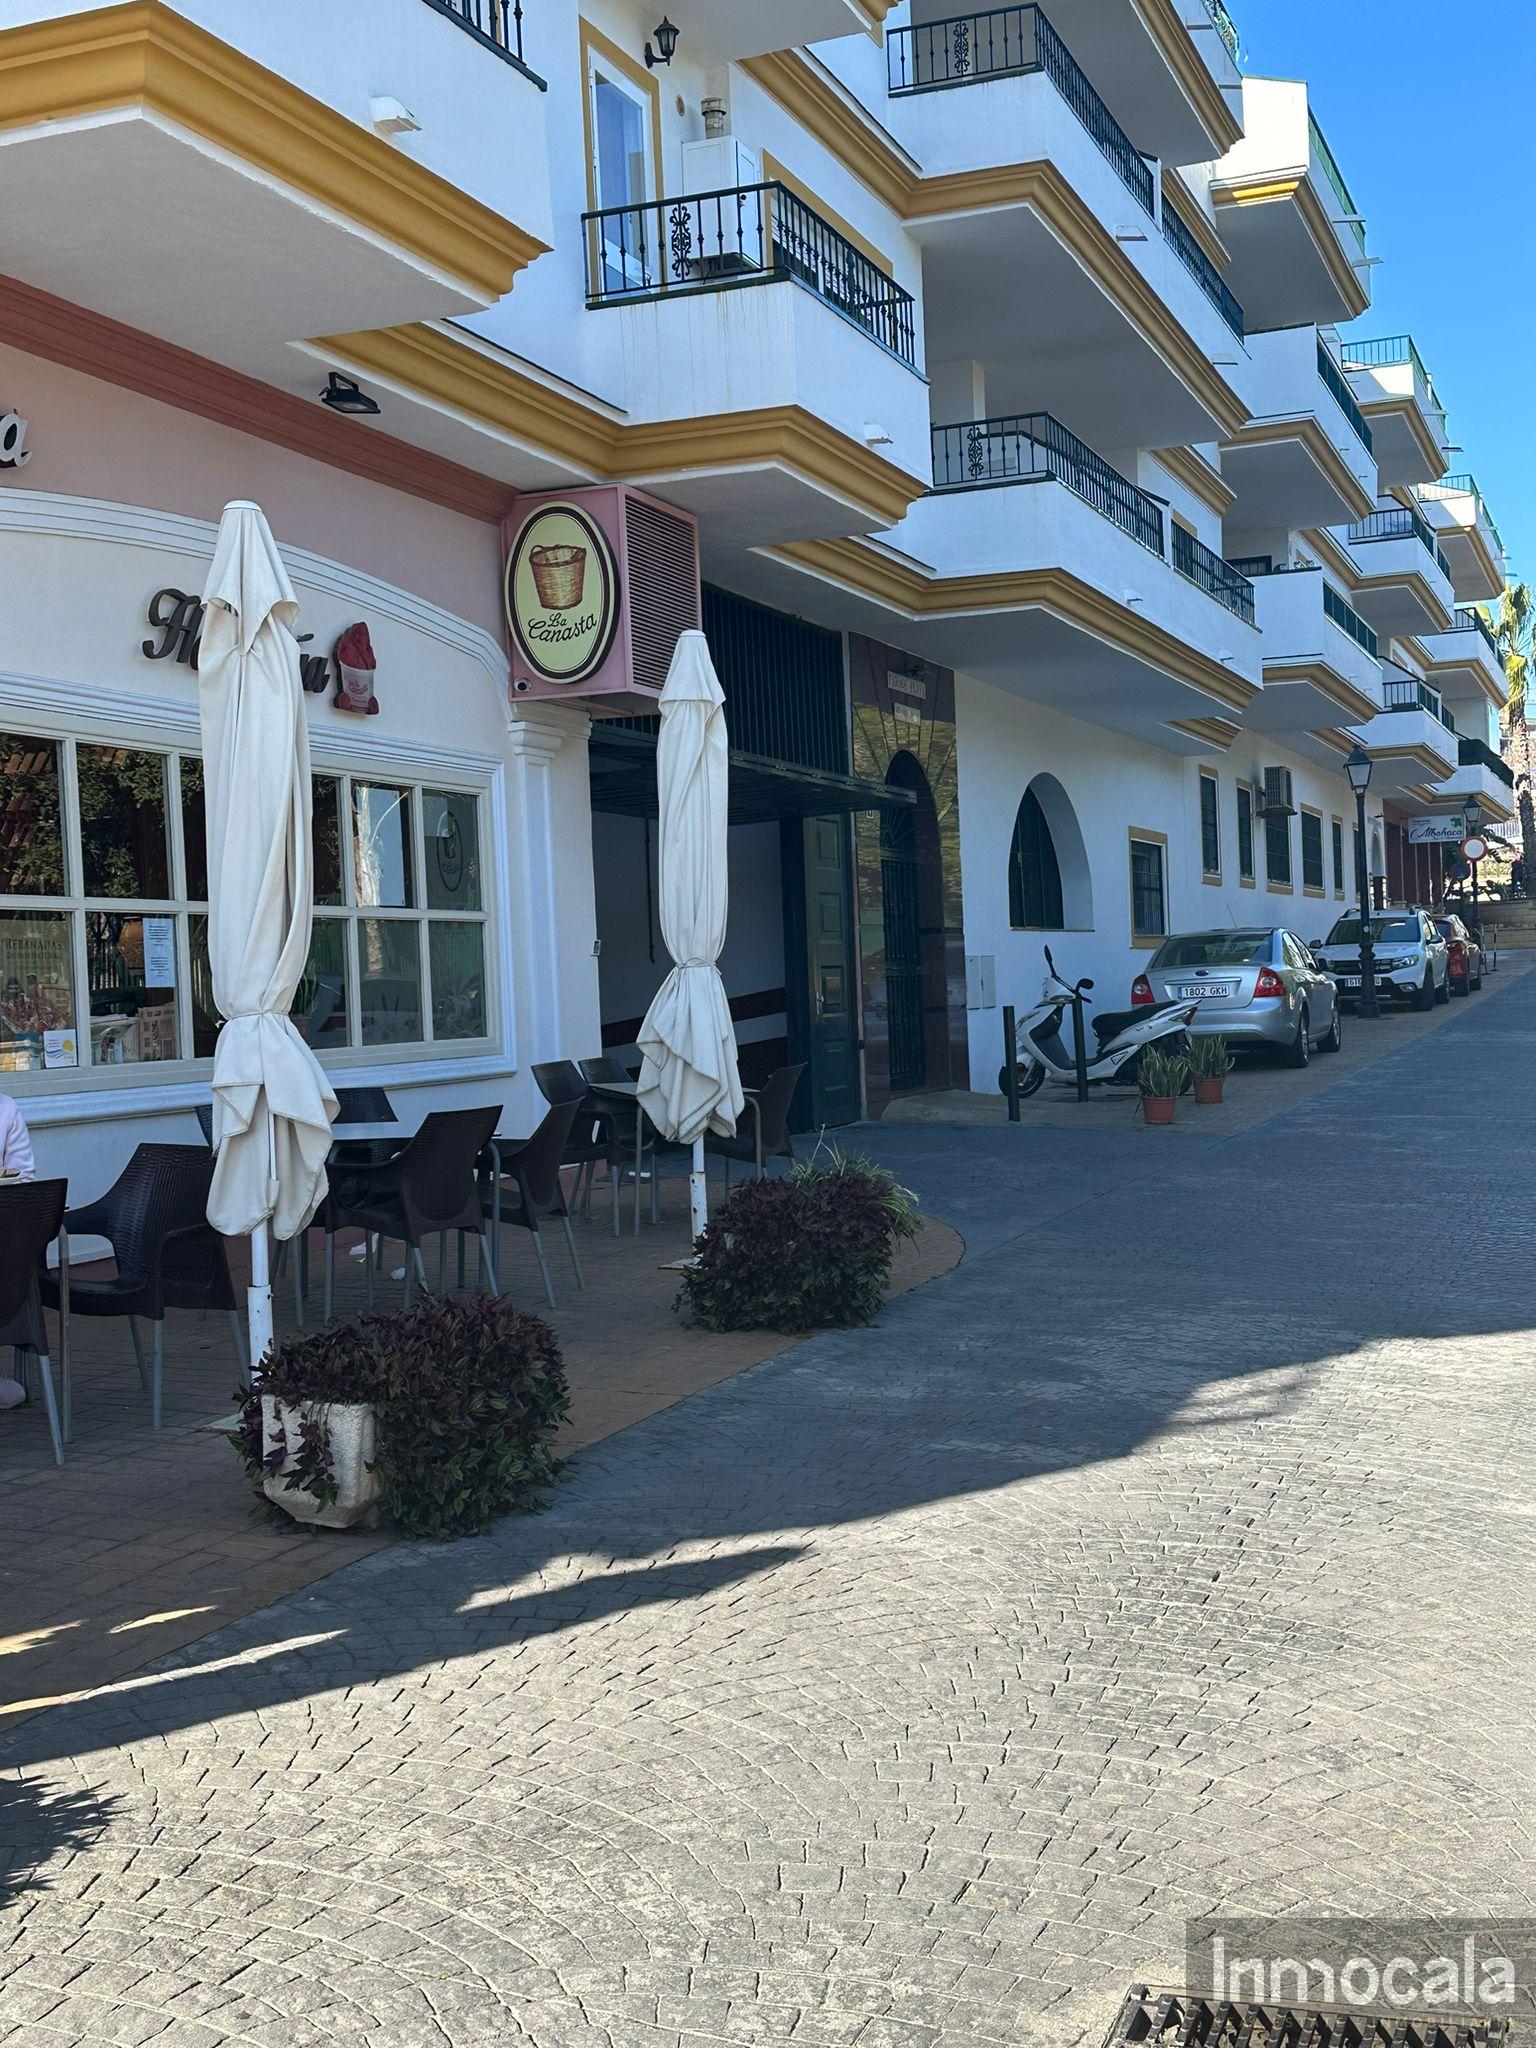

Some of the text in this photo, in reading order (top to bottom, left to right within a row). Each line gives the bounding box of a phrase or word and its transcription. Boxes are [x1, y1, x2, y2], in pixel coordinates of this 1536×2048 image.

[527, 612, 598, 643] Canasta
[547, 612, 568, 628] La
[1185, 985, 1228, 997] 1802 GKH
